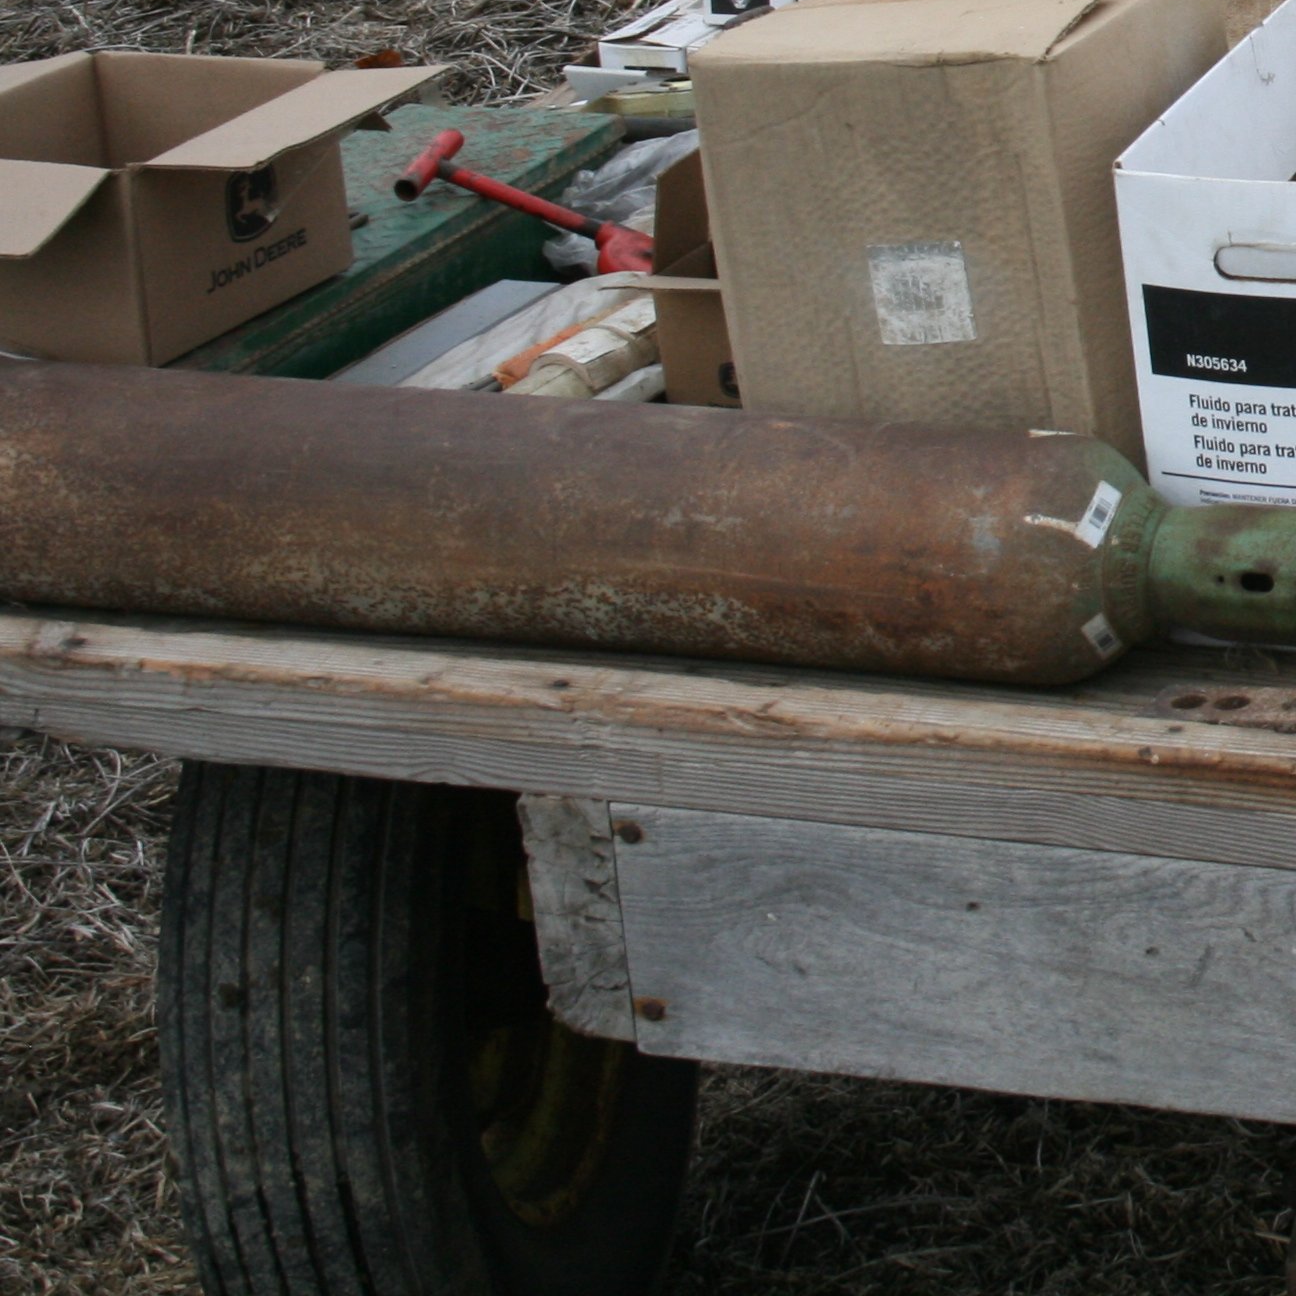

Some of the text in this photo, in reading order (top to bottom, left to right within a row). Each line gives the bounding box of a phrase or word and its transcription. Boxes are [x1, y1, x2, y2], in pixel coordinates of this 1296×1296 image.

[206, 228, 308, 294] JOHN DEERE
[1186, 353, 1247, 373] N305634
[1189, 394, 1231, 413] Fluido
[1236, 400, 1267, 417] para
[1191, 413, 1268, 434] de invierno
[1194, 435, 1235, 454] Fluido
[1240, 441, 1271, 458] para
[1196, 454, 1268, 474] de inverno
